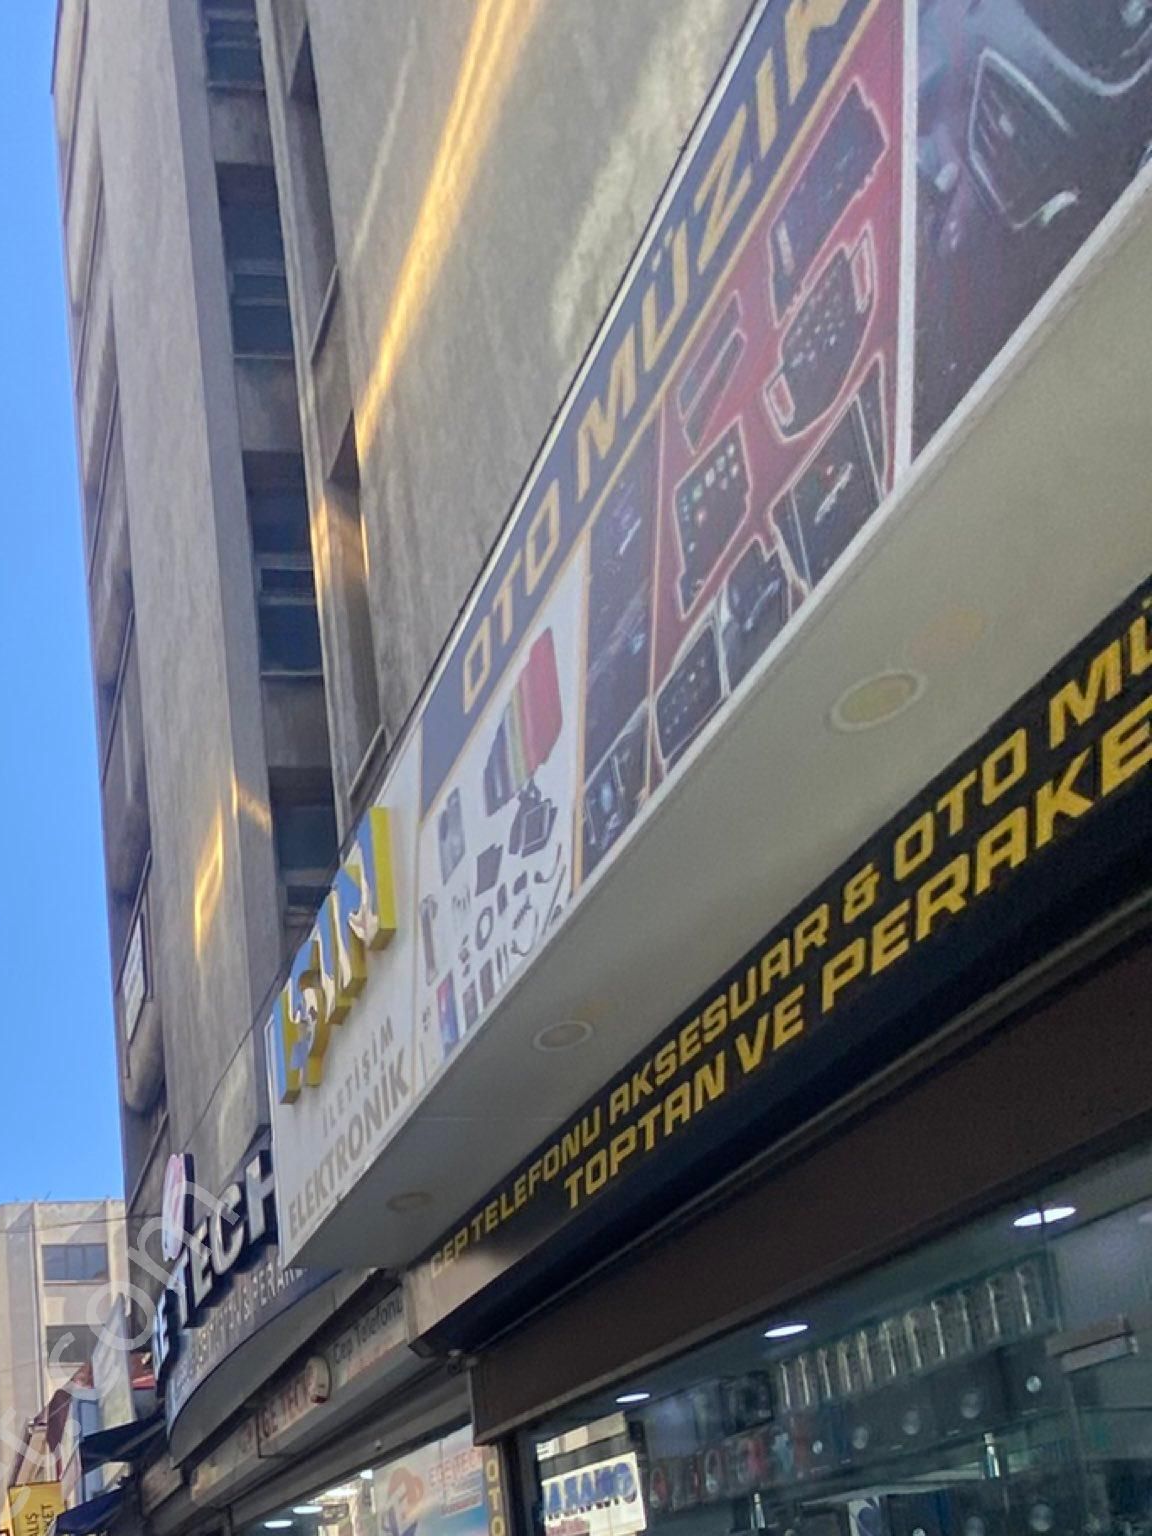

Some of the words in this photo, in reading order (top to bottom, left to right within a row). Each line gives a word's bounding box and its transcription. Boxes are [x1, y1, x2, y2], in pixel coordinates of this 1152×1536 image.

[462, 478, 559, 714] OTO
[431, 1231, 468, 1278] CEP
[468, 1105, 601, 1243] TELEFONU
[608, 902, 830, 1126] AKSESUAR
[841, 862, 881, 924] &
[893, 727, 1028, 882] OTO
[563, 1050, 725, 1210] TOPTAN
[736, 984, 806, 1075] VE
